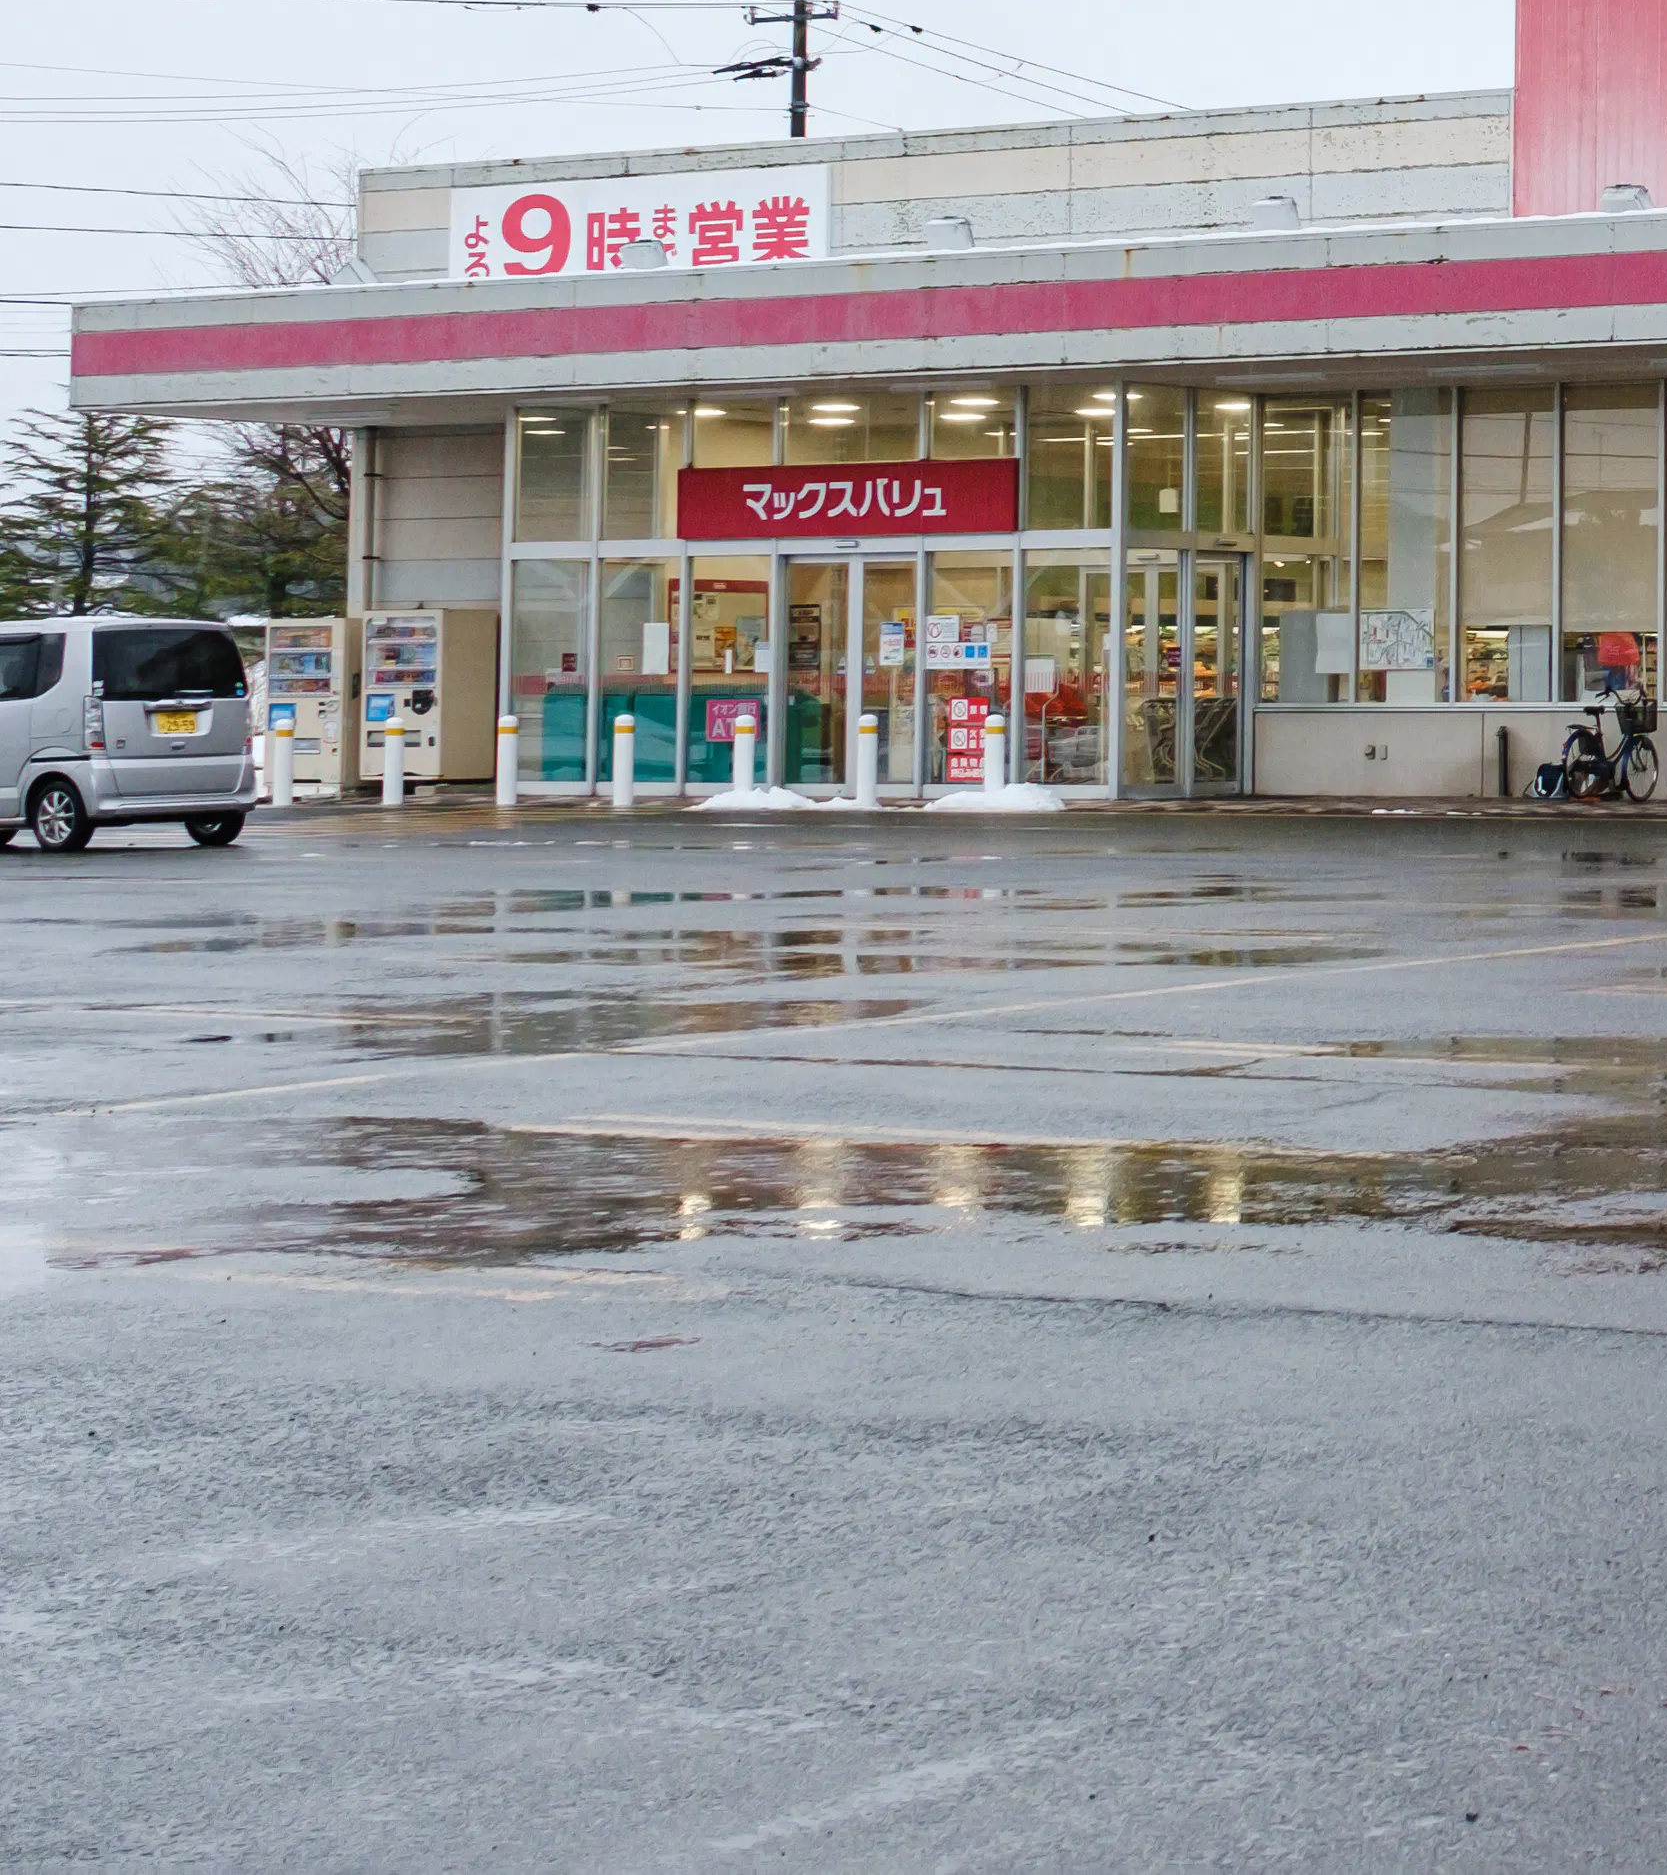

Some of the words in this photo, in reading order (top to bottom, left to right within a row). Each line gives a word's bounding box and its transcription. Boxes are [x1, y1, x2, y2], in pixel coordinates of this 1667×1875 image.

[742, 477, 948, 520] マックスバリュ
[711, 717, 737, 738] AT
